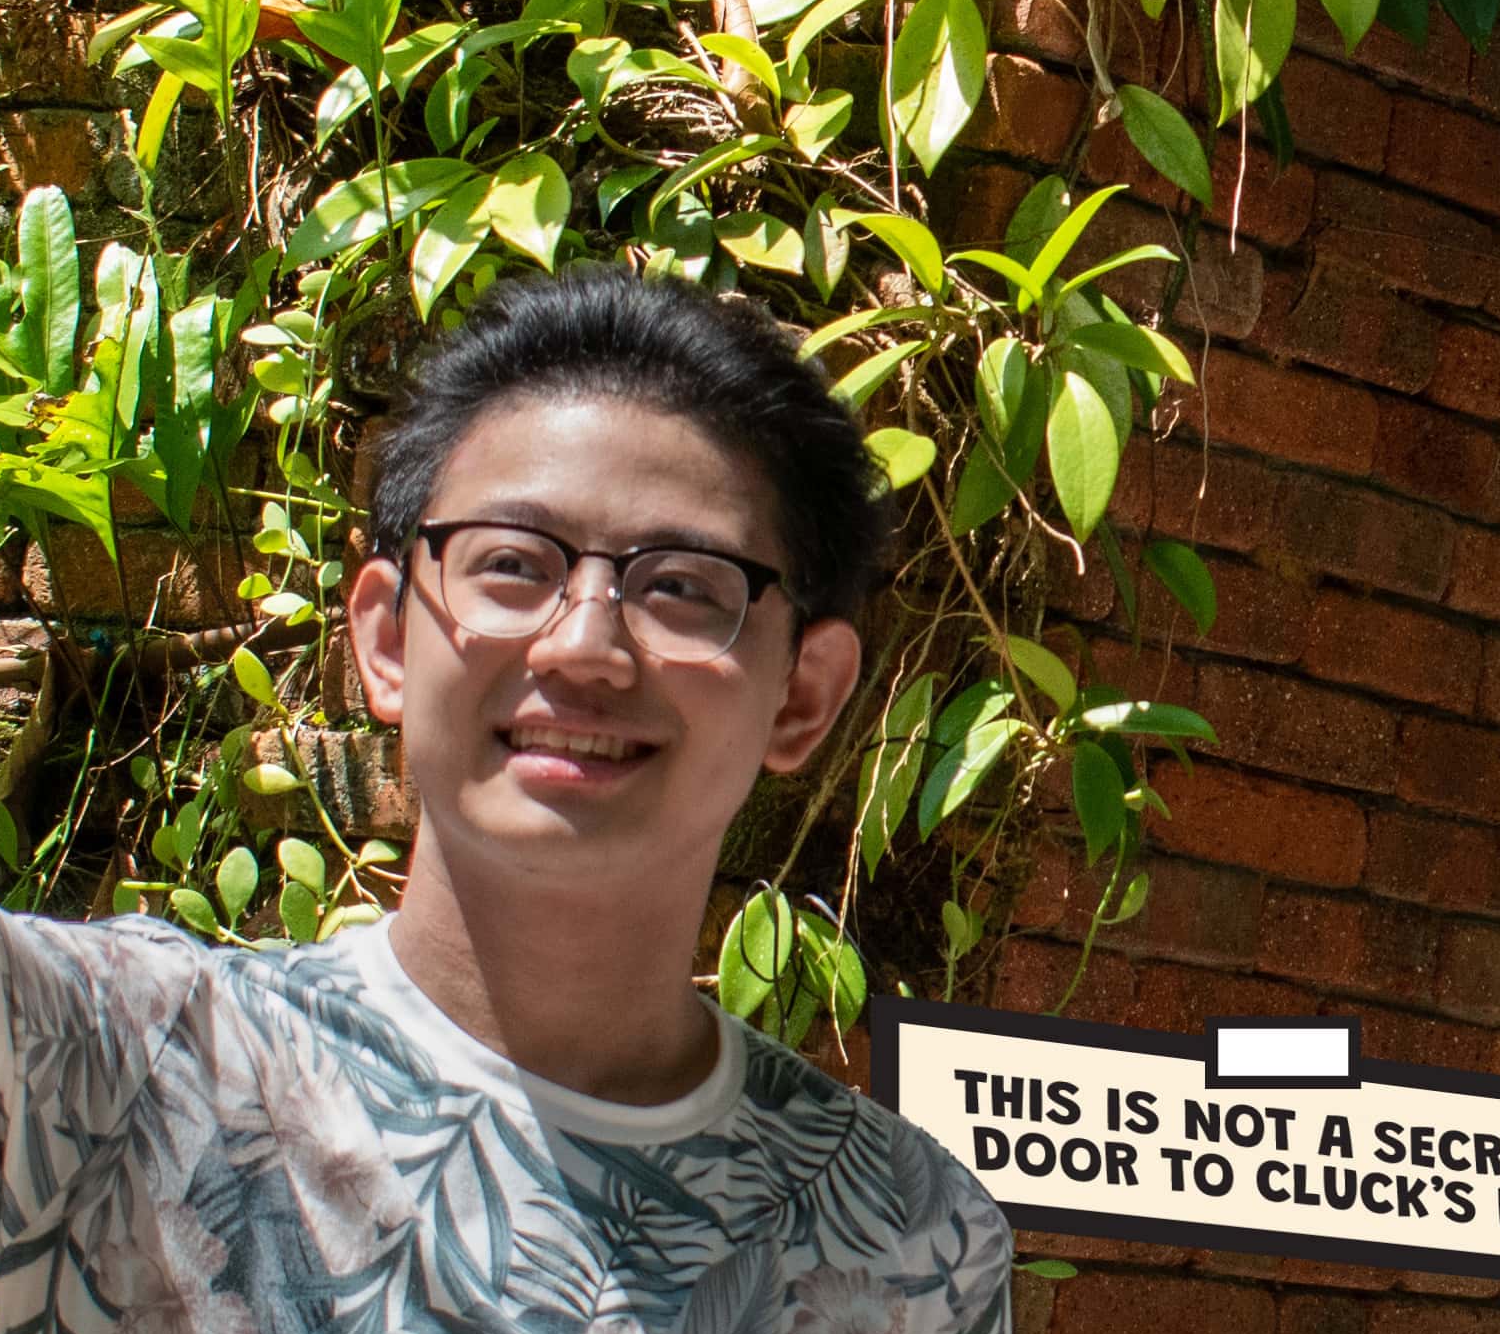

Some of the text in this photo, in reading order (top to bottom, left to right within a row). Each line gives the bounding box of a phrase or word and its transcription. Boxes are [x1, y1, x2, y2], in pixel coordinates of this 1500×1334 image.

[954, 1069, 1081, 1126] THIS
[1107, 1087, 1160, 1135] IS
[1184, 1098, 1296, 1151] NOT
[1317, 1114, 1354, 1159] A
[972, 1126, 1139, 1186] DOOR
[1160, 1147, 1234, 1197] TO
[1256, 1160, 1476, 1224] CLUCK'S
